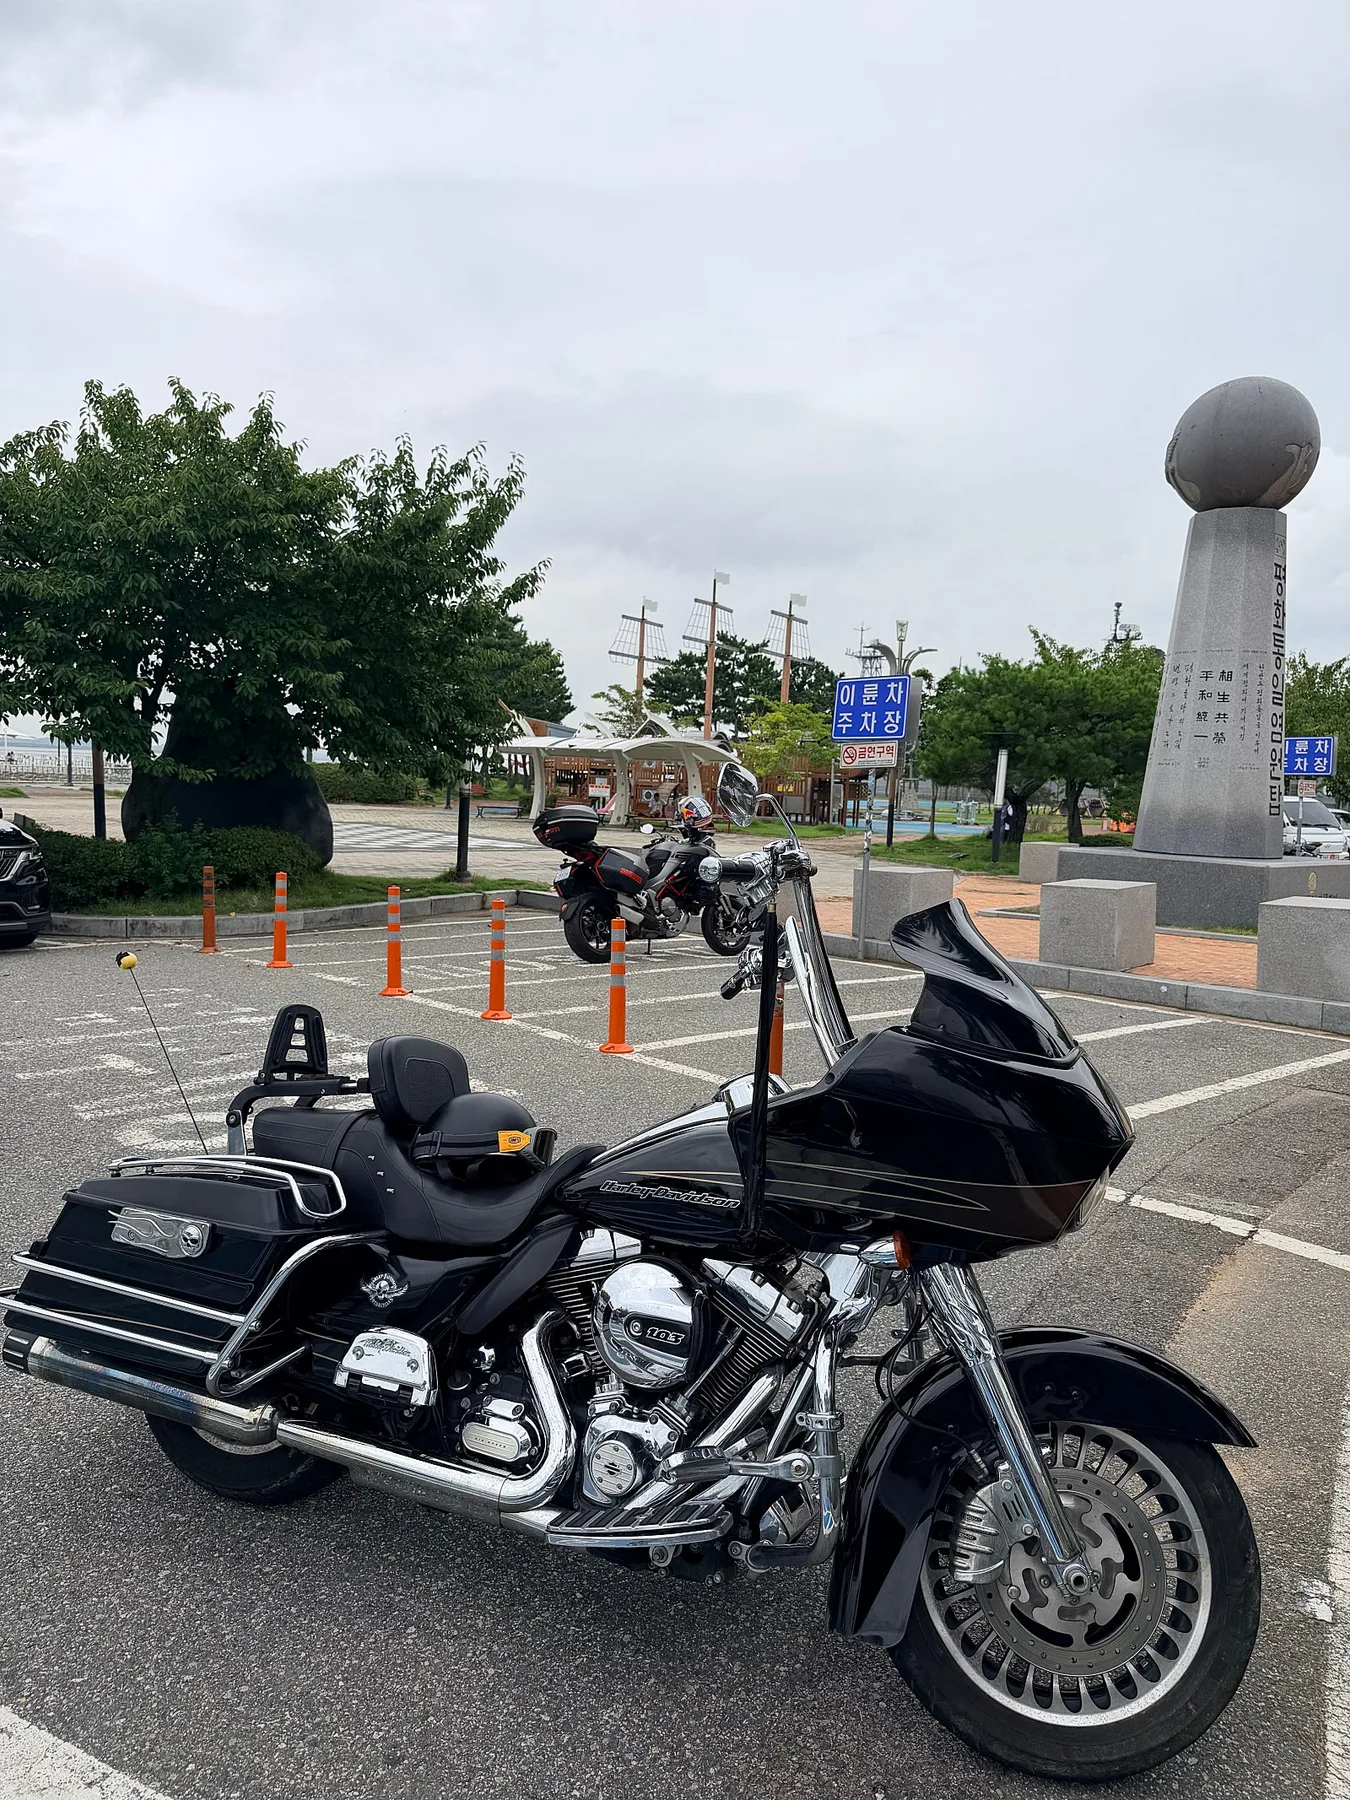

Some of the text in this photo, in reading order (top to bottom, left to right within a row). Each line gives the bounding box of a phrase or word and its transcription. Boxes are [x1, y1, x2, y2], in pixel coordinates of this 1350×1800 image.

[839, 681, 904, 707] 이륜차
[836, 710, 902, 735] 주차장
[858, 745, 894, 759] 금연구역
[599, 1179, 741, 1209] Harley-Davidson
[645, 1326, 686, 1345] 103
